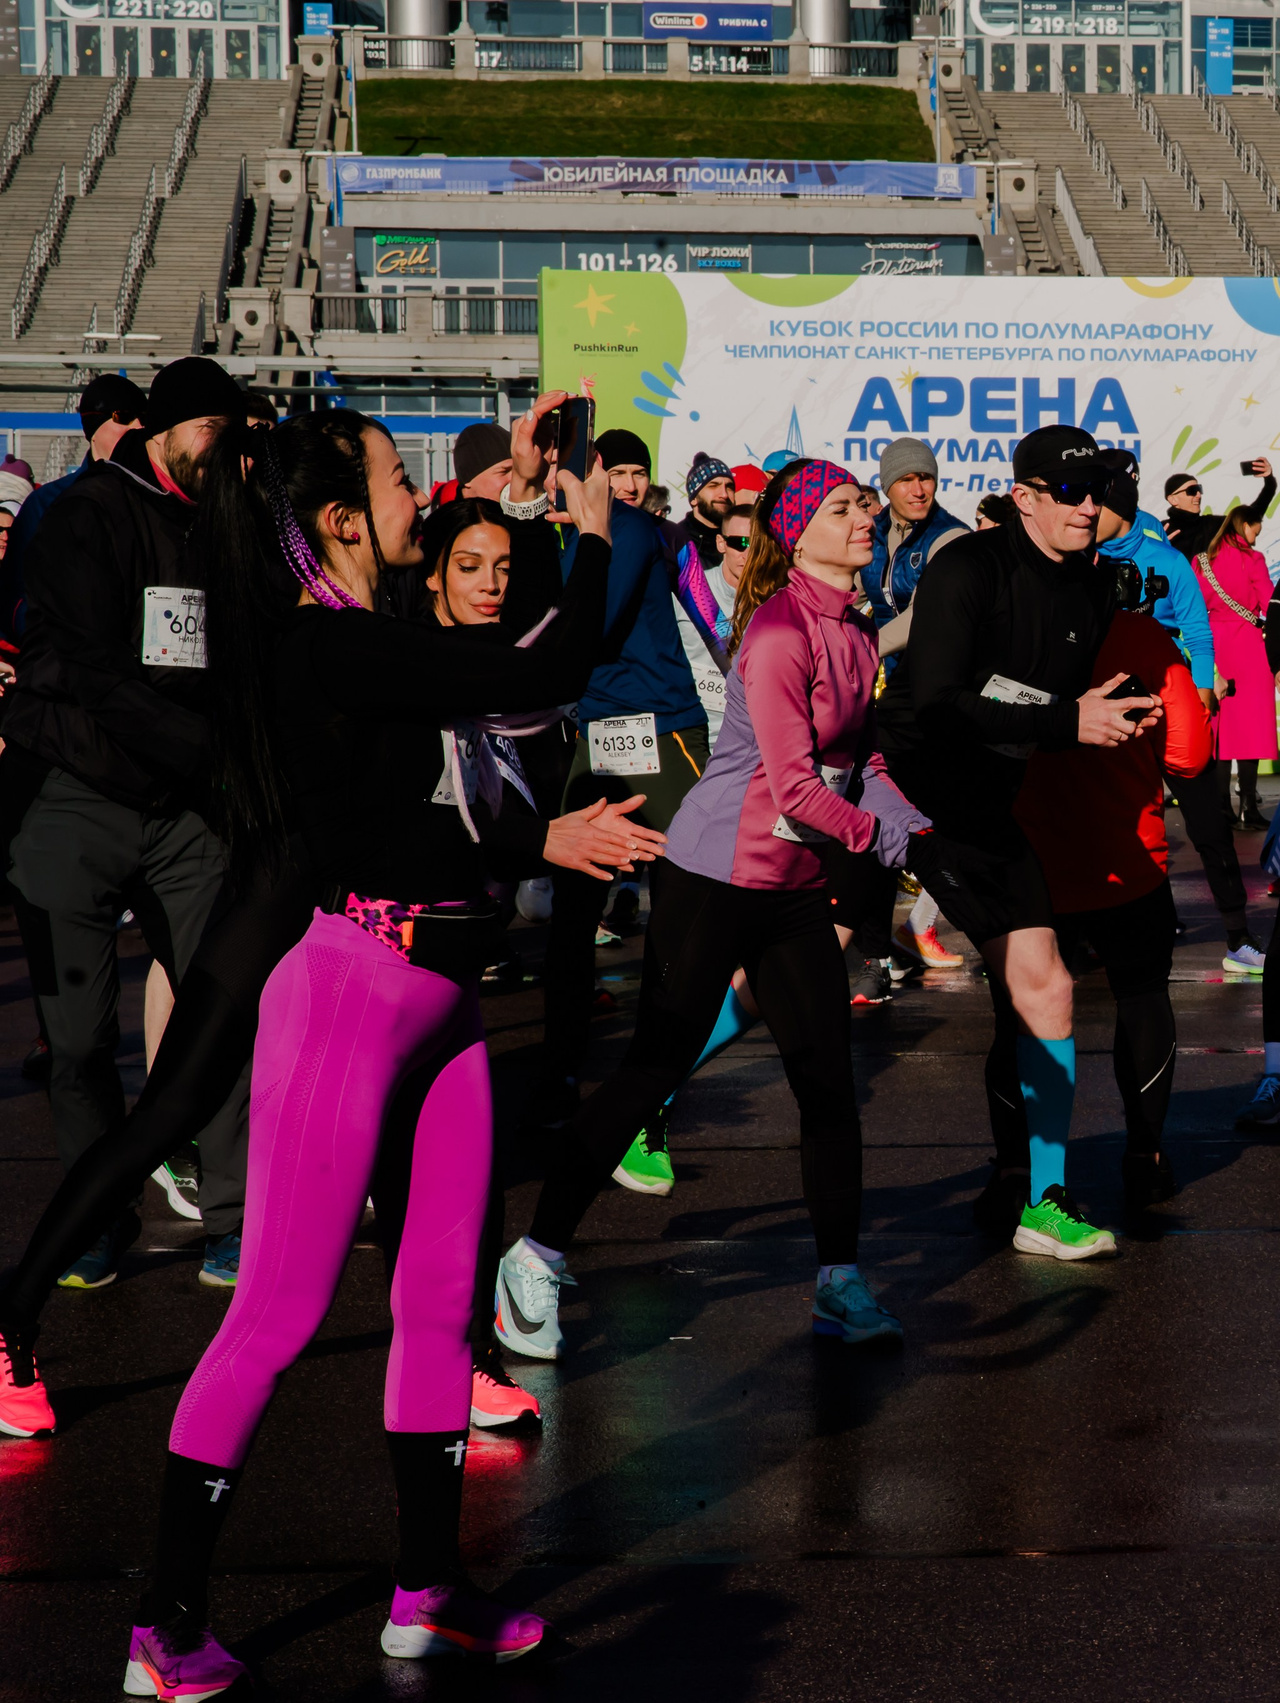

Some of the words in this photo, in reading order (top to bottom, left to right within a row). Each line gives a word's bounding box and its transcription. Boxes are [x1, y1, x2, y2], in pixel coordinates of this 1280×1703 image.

[655, 16, 691, 26] Winline
[718, 18, 759, 27] ТРИБУНА
[364, 40, 386, 49] НЫЙ
[366, 167, 442, 180] ГАЗПРОМБАНК
[543, 162, 668, 183] ЮБИЛЕЙНАЯ
[673, 167, 789, 186] ПЛОЩАДКА
[689, 246, 709, 257] VIP
[710, 247, 749, 258] ЛОЖИ
[376, 245, 430, 274] Gold
[697, 259, 713, 267] SKY
[769, 319, 854, 338] КУБОК
[859, 321, 958, 338] РОССИИ
[964, 321, 998, 339] ПО
[1004, 322, 1214, 340] ПОЛУМАРАФОНУ
[573, 342, 639, 352] PushkinRun
[724, 344, 850, 359] ЧЕМПИОНАТ
[854, 345, 1054, 361] САНКТ-ПЕТЕРБУРГА
[1058, 347, 1085, 361] ПО
[1090, 348, 1258, 362] ПОЛУМАРАФОНУ
[847, 375, 1140, 434] АРЕНА
[1018, 690, 1043, 704] АРЕНА
[602, 735, 636, 752] 6133
